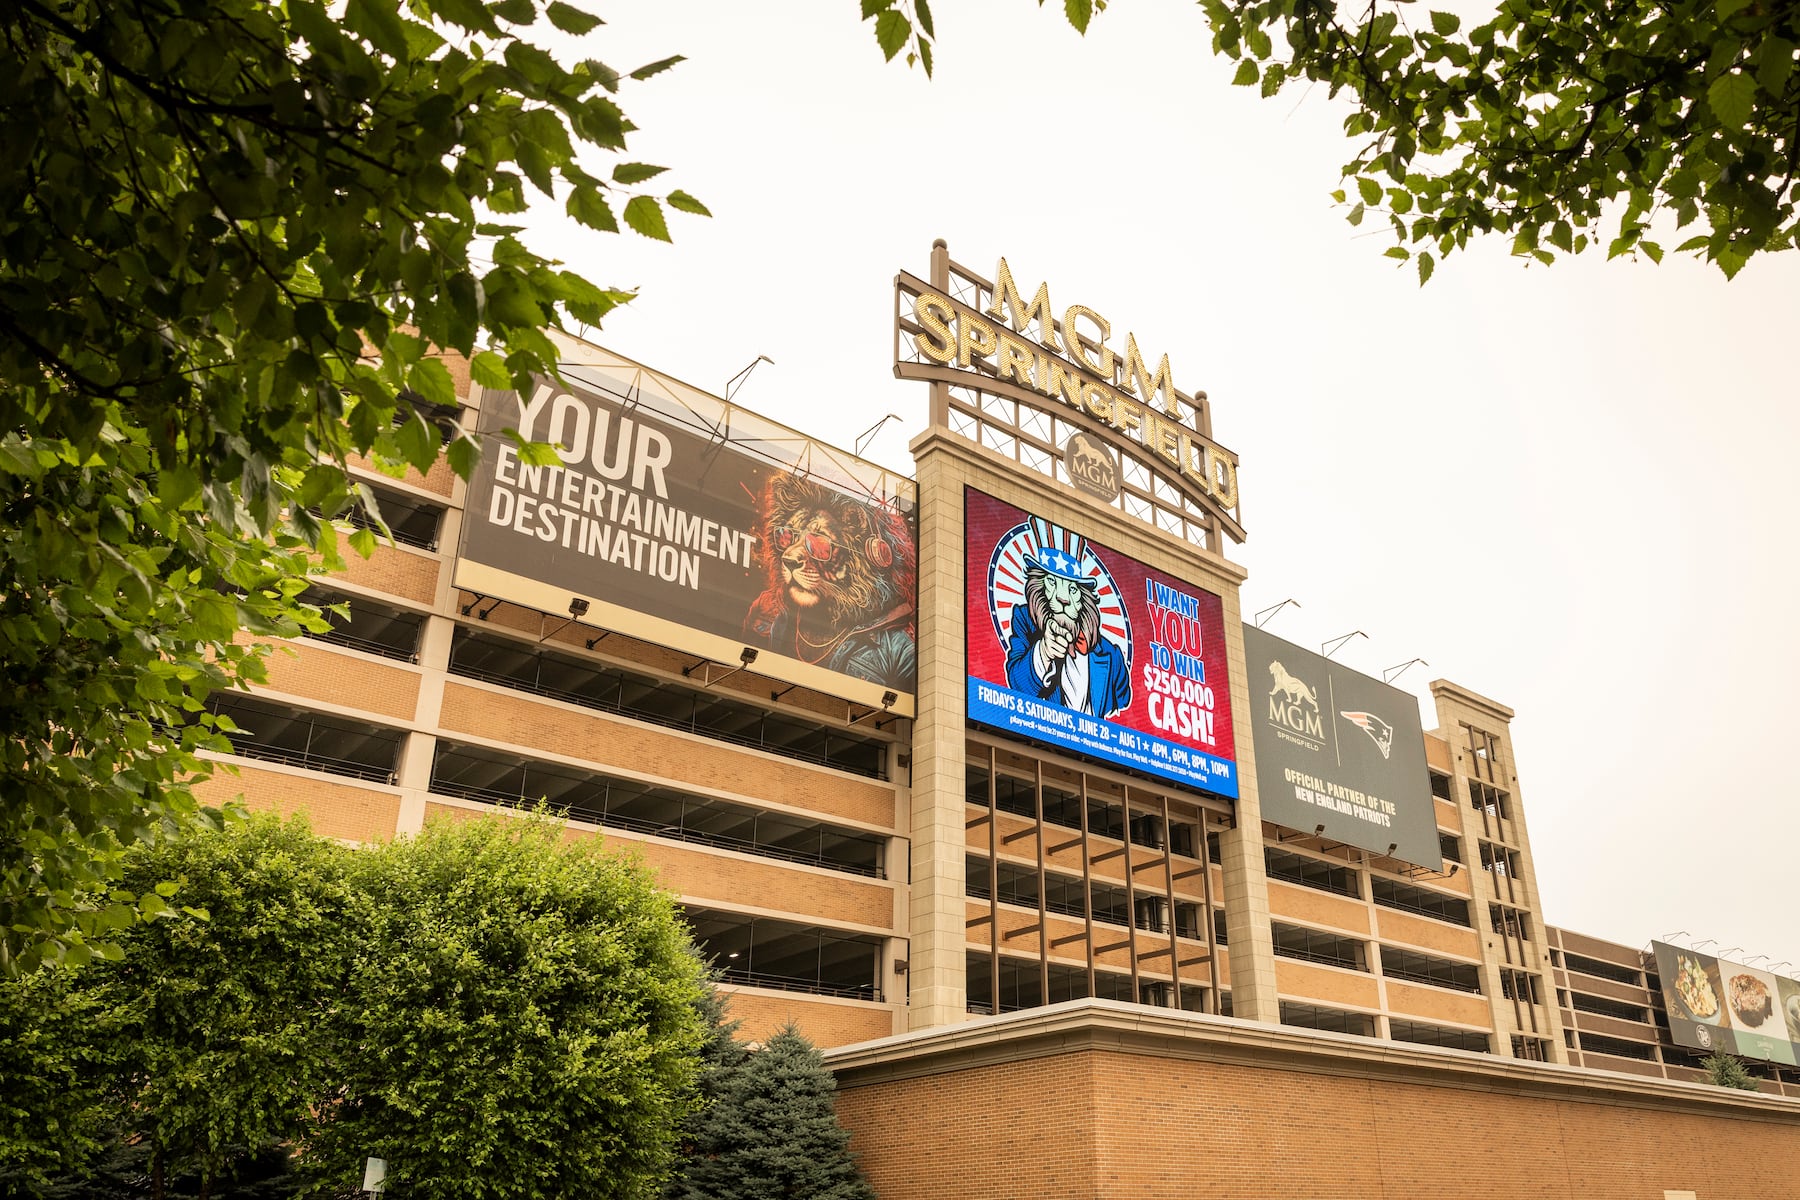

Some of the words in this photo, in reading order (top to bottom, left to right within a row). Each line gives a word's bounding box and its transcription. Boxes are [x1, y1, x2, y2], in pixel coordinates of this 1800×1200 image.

[985, 256, 1183, 421] MGM
[912, 292, 1238, 511] SPRINGFIELD
[514, 384, 672, 498] YOUR
[1072, 457, 1117, 492] MGM
[494, 444, 757, 569] ENTERTAINMENT
[488, 485, 700, 590] DESTINATION
[1146, 578, 1153, 602] I
[1155, 581, 1199, 620] WANT
[1147, 601, 1202, 658] YOU
[1143, 663, 1215, 711] $250,000
[1150, 641, 1171, 670] TO
[1172, 651, 1205, 684] WIN
[978, 685, 1015, 710] FRIDAYS
[1016, 698, 1024, 713] &
[1025, 700, 1076, 732] SATURDAYS,
[1077, 717, 1098, 737] JUNE
[1099, 724, 1109, 740] 28
[1119, 731, 1135, 749] AUG
[1136, 736, 1141, 750] 1
[1172, 748, 1190, 768] 6PM,
[1191, 755, 1209, 774] 8PM,
[1210, 760, 1229, 778] 10PM
[1148, 692, 1216, 746] CASH!
[1269, 695, 1325, 739] MGM
[1277, 731, 1319, 751] SPRINGFIELD
[1284, 768, 1326, 793] OFFICIAL
[1327, 781, 1366, 806] PARTNER
[1367, 795, 1379, 809] OF
[1379, 799, 1396, 815] THE
[1294, 785, 1314, 804] NEW
[1315, 792, 1352, 816] ENGLAND
[1353, 805, 1391, 827] PATRIOTS
